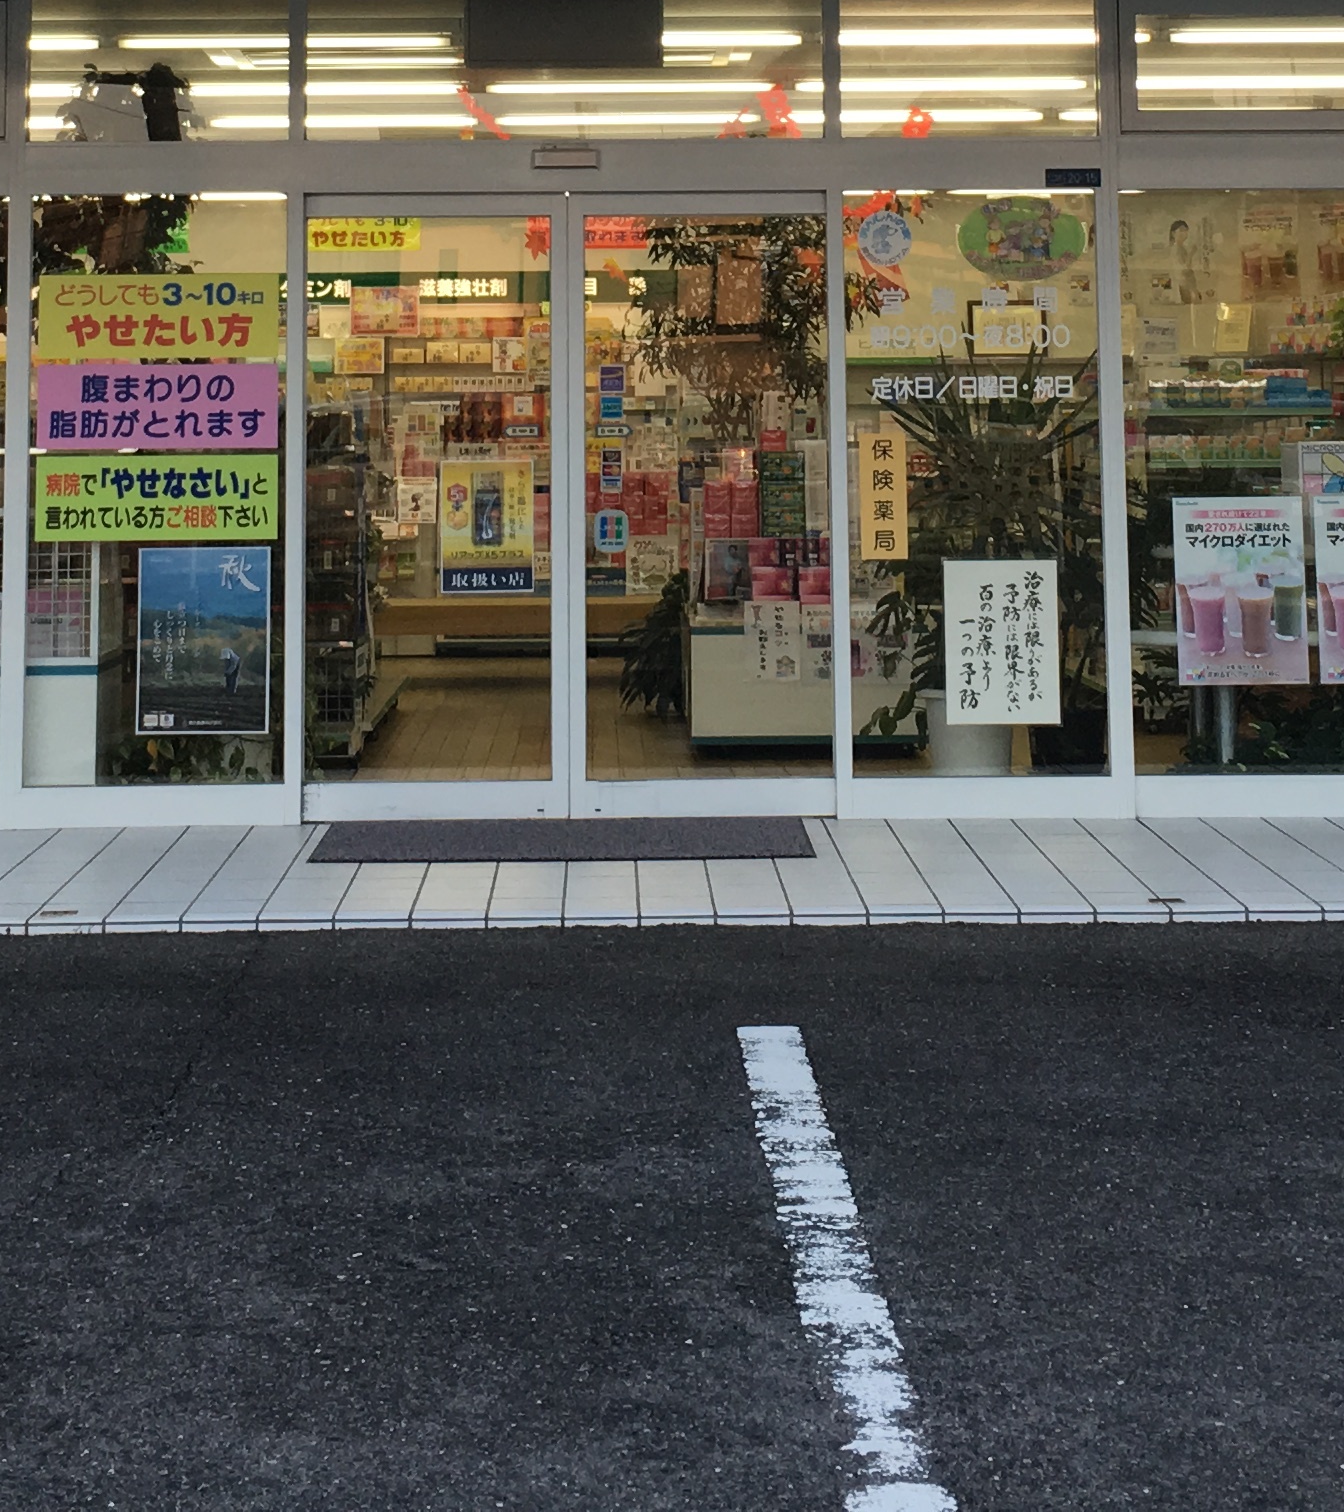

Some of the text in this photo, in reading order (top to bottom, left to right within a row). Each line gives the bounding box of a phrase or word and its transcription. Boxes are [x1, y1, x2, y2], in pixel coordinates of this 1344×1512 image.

[312, 230, 406, 248] やせたい方
[419, 278, 508, 297] 滋養強壮剤
[66, 313, 253, 348] やせたい方
[81, 374, 235, 403] 腹まわりの
[49, 409, 265, 438] 脂肪がとれます
[46, 468, 269, 500] 病院で「やせなさい」と
[872, 439, 895, 552] 保険薬局
[45, 505, 269, 530] 言われている方ご相談下さい
[1185, 522, 1290, 533] 国内270万人に選ばれた
[1185, 533, 1291, 548] マイクロダイエット
[219, 554, 261, 592] 秋
[452, 572, 525, 588] 取扱い店
[959, 619, 981, 710] 一つの予防
